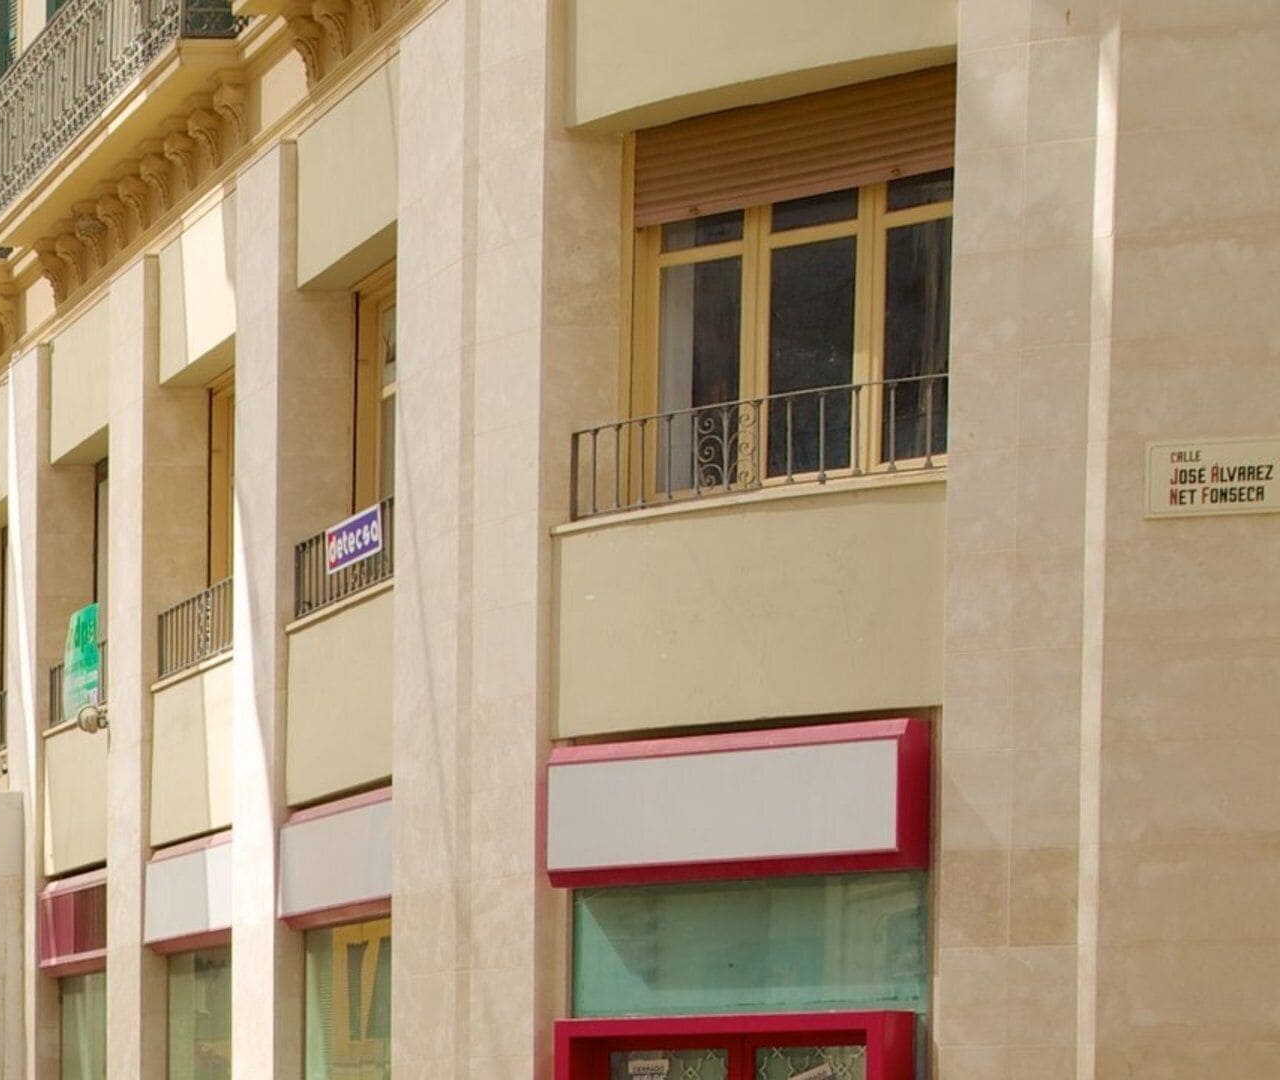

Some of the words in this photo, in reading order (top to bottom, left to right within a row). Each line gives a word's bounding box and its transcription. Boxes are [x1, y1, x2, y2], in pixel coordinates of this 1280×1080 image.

[1170, 450, 1202, 463] CALLE
[1169, 487, 1197, 506] NET
[1201, 485, 1265, 505] FONSECA
